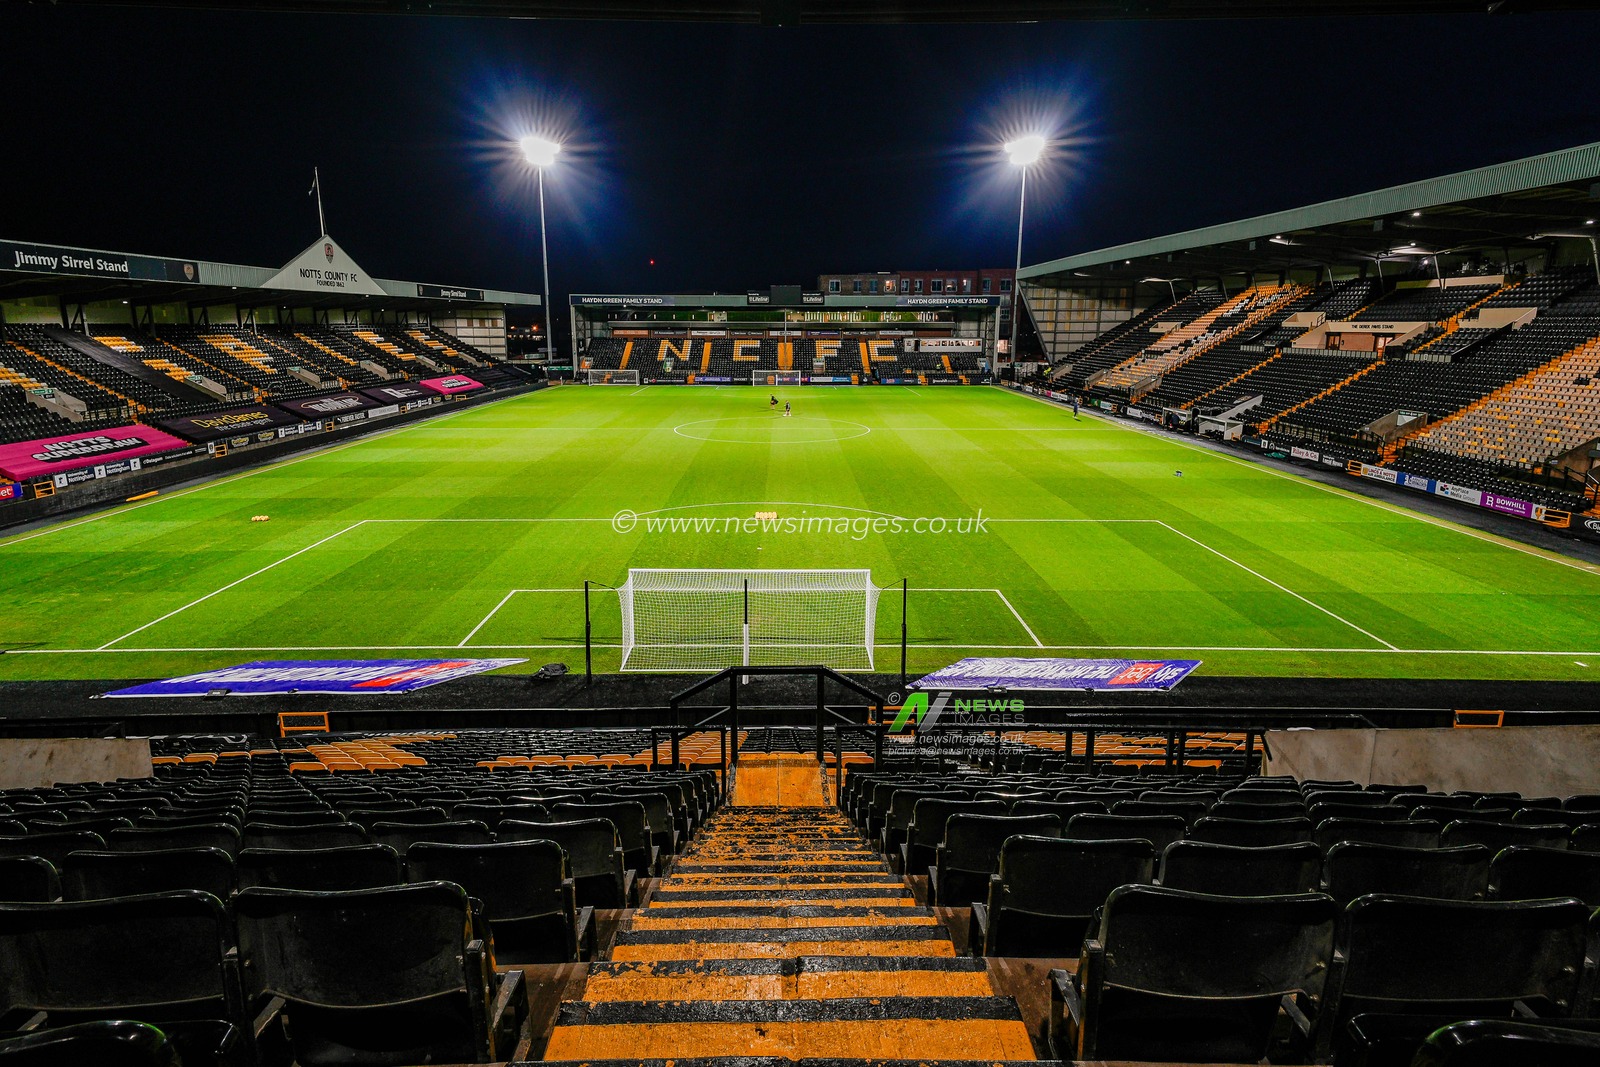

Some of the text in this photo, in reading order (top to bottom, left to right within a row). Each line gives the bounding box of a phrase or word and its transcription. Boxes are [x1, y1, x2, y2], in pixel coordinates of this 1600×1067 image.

[15, 251, 128, 272] Jimmy Sirrel Stand
[300, 268, 357, 282] NOTTS COUNTY FC
[657, 339, 897, 361] N C F C
[32, 438, 142, 461] SUPERDRAW
[43, 436, 111, 451] NOTTS
[1293, 448, 1305, 457] Riley
[107, 466, 130, 475] Nottingham
[68, 473, 94, 483] Nottingham
[1496, 498, 1526, 510] BOWHILL
[1120, 664, 1187, 683] sky bet
